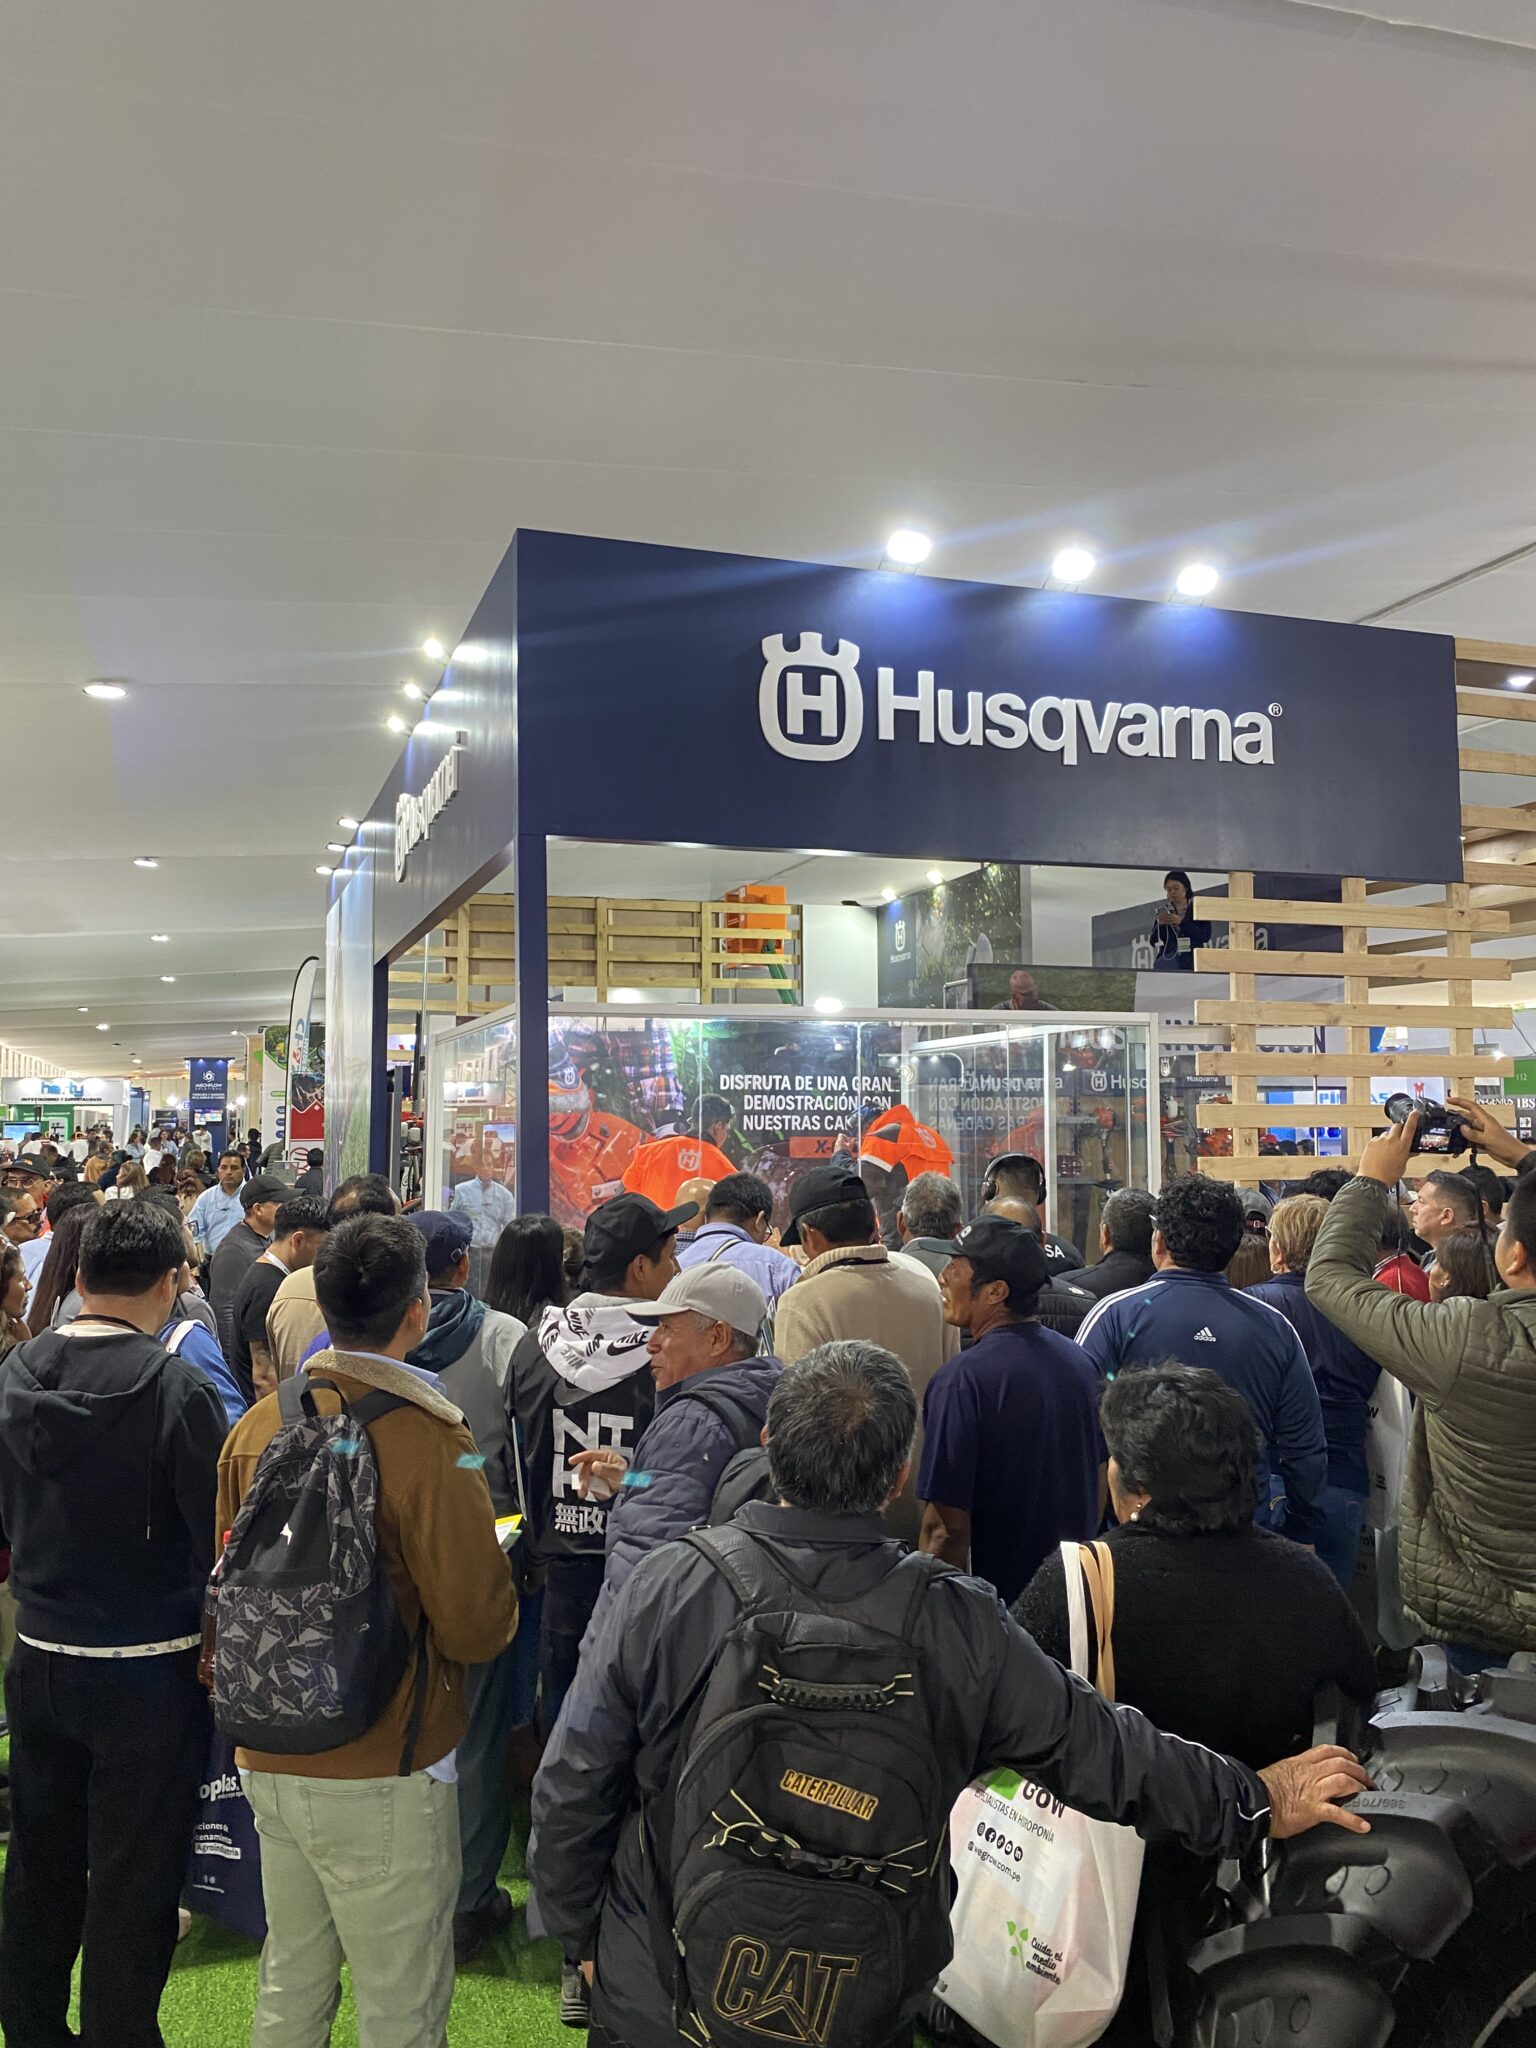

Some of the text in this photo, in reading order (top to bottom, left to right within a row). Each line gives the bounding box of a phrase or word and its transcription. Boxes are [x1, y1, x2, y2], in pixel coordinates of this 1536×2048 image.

[720, 1074, 892, 1092] DISFRUTA DE UNA GRAN
[744, 1092, 859, 1111] DEMOSTRACIÓN
[743, 1114, 821, 1131] NUESTRAS
[783, 1769, 878, 1819] CATERPILLAR
[1032, 1953, 1057, 1970] medio
[1025, 1961, 1061, 1985] ambiente
[713, 1935, 861, 2047] CAT
